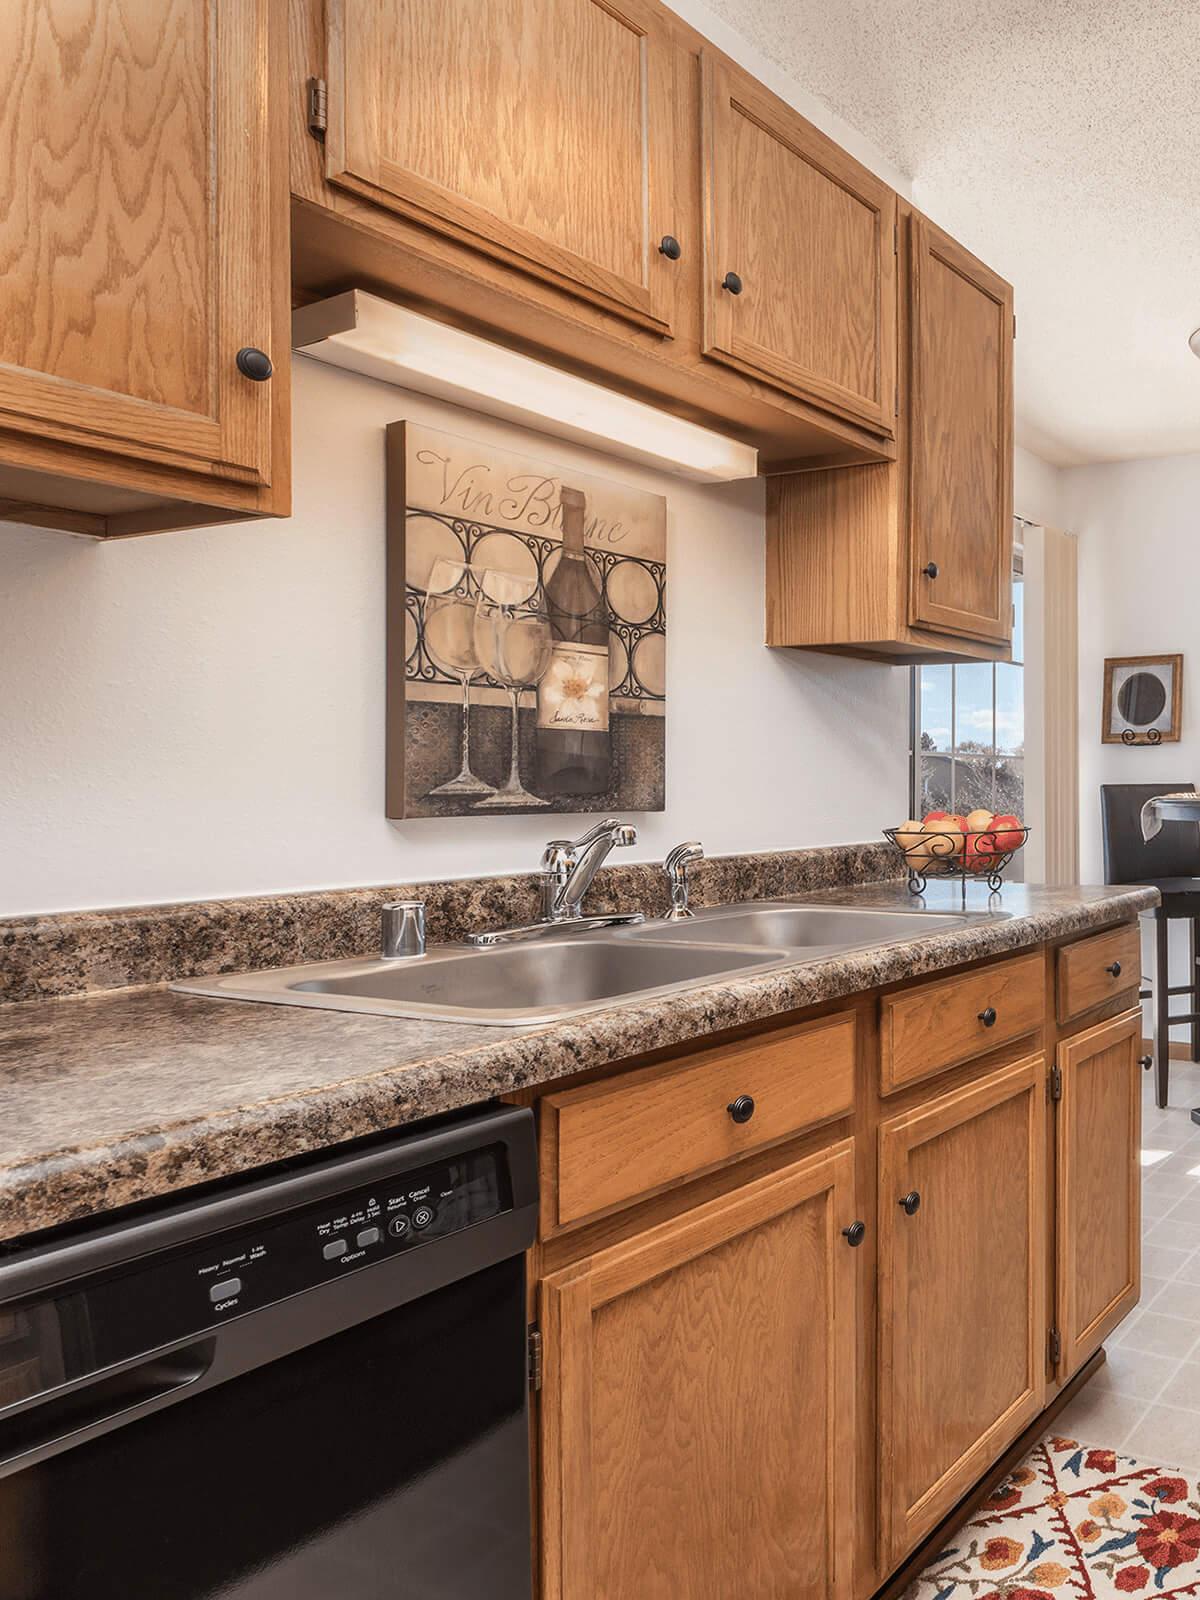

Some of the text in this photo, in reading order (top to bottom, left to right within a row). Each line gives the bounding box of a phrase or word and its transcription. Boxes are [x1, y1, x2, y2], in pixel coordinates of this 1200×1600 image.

[416, 450, 493, 516] Vin
[408, 1185, 431, 1199] Cancel
[388, 1195, 405, 1206] Start
[319, 1228, 330, 1236] Dry
[222, 1254, 246, 1267] Normal
[340, 1250, 366, 1264] Options
[214, 1298, 238, 1311] Cycles
